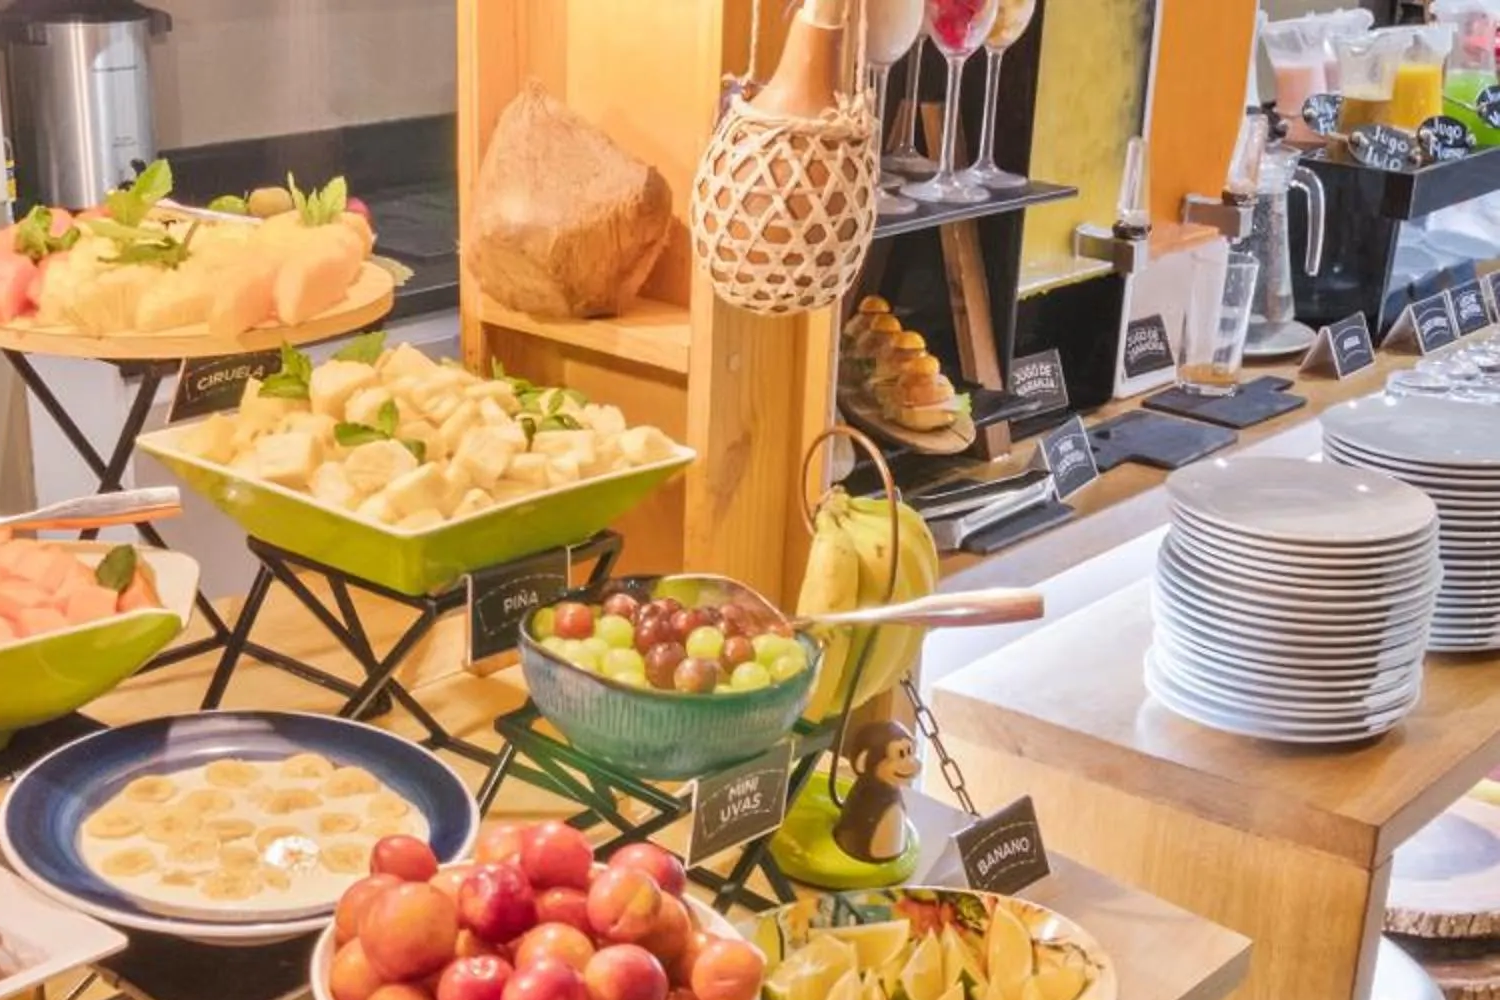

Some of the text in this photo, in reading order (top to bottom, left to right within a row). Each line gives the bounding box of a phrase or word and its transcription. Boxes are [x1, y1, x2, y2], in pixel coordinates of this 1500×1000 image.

[1372, 125, 1409, 155] Jugo
[197, 363, 265, 391] CIRUELA
[503, 588, 540, 615] PIÑA
[728, 776, 760, 801] MINI
[721, 791, 763, 823] UVAS
[977, 836, 1031, 876] BANANO
